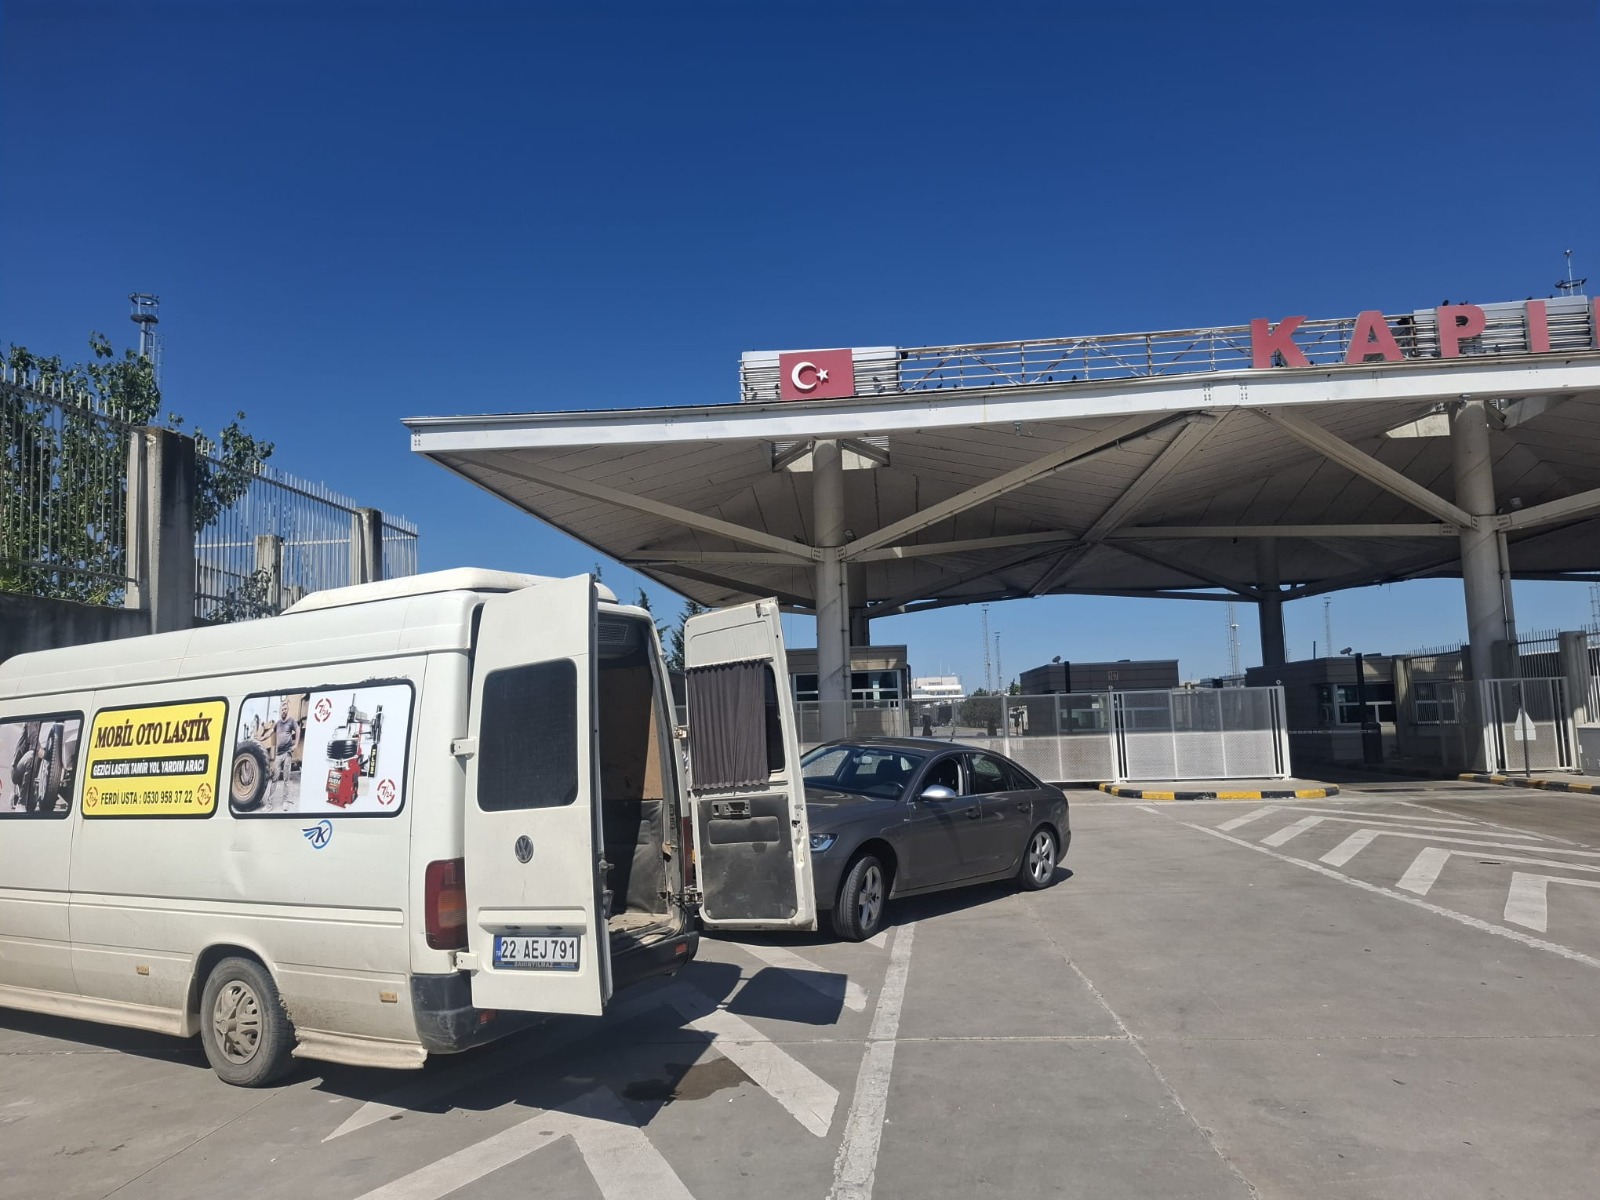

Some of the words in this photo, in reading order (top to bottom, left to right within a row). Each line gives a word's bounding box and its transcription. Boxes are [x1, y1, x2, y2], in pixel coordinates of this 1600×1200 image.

[1250, 296, 1600, 368] KAPI
[94, 718, 134, 748] MOBİL
[136, 722, 162, 745] OTO
[163, 712, 212, 744] LASTİK
[93, 761, 111, 776] GEZİCİ
[111, 760, 130, 775] LASTİK
[149, 761, 160, 774] YOL
[185, 759, 204, 772] ARACI
[100, 790, 119, 805] FERDİ
[121, 791, 137, 805] USTA
[143, 791, 159, 804] 0530
[160, 790, 173, 803] 958
[174, 790, 183, 803] 37
[184, 790, 193, 803] 22
[501, 940, 516, 958] 22
[524, 940, 547, 959] AEJ
[551, 940, 574, 959] 791
